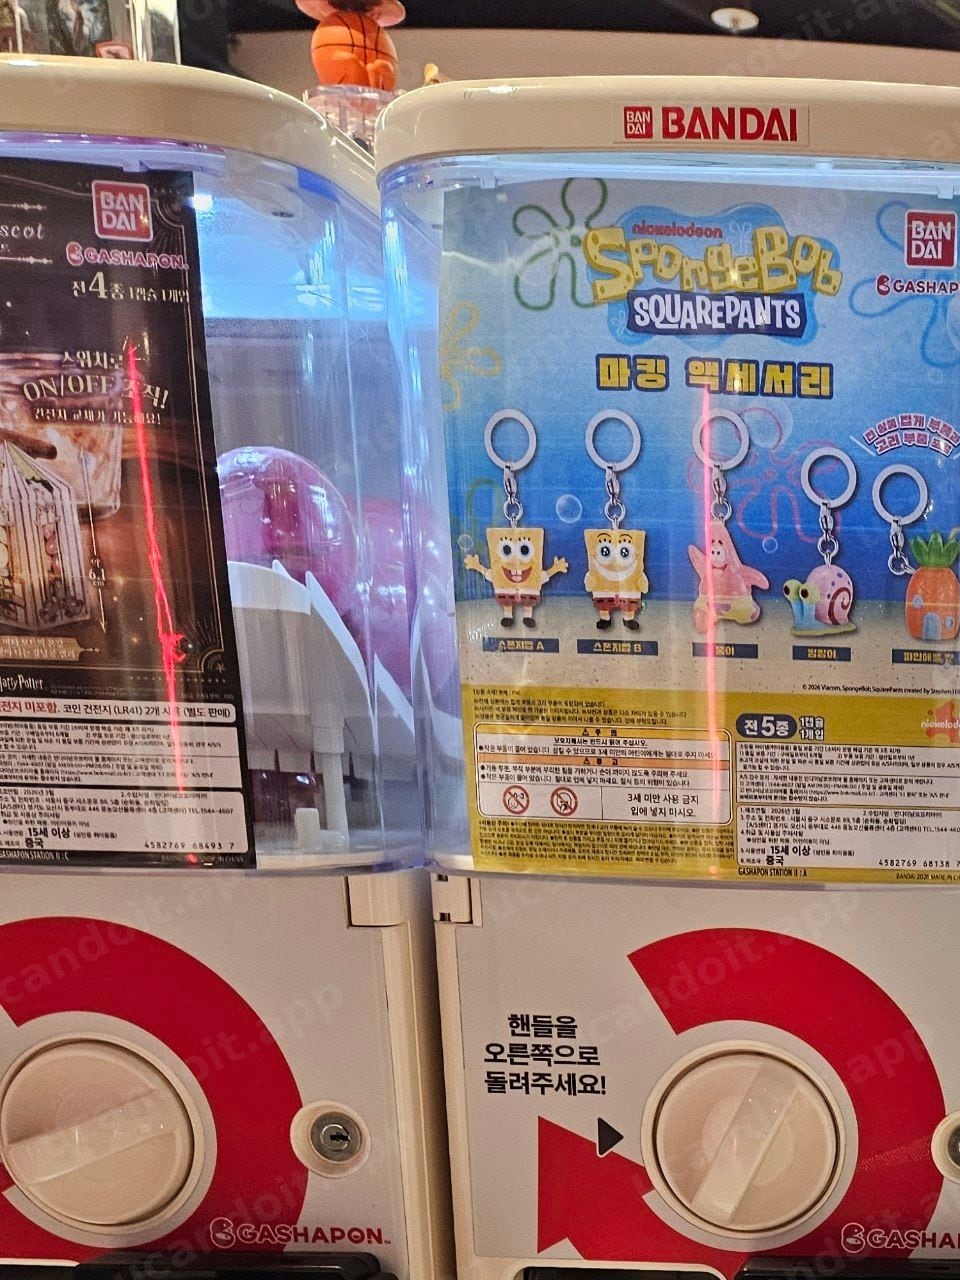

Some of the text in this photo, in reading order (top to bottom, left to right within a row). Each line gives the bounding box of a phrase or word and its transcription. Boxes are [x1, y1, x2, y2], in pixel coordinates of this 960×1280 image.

[626, 111, 650, 123] BAN
[662, 107, 796, 141] BANDAI
[627, 122, 646, 135] DAI
[100, 192, 143, 211] BAN
[102, 210, 136, 231] DAI
[911, 220, 951, 241] BAN
[911, 241, 943, 259] DAI
[634, 296, 800, 329] SQUAREPANTS
[596, 355, 834, 399] 마킹 액세서리
[743, 716, 790, 737] 전5종
[627, 793, 699, 805] 3세 미만 사용 금지
[630, 806, 647, 817] 입에
[649, 806, 667, 818] 넣지
[766, 855, 784, 866] 중국
[770, 845, 811, 856] 15세 이상
[878, 859, 917, 867] 4582769
[923, 859, 950, 867] 68138
[508, 1014, 577, 1038] 핸들을
[483, 1042, 601, 1067] 오른쪽으로
[484, 1070, 607, 1096] 돌려주세요!
